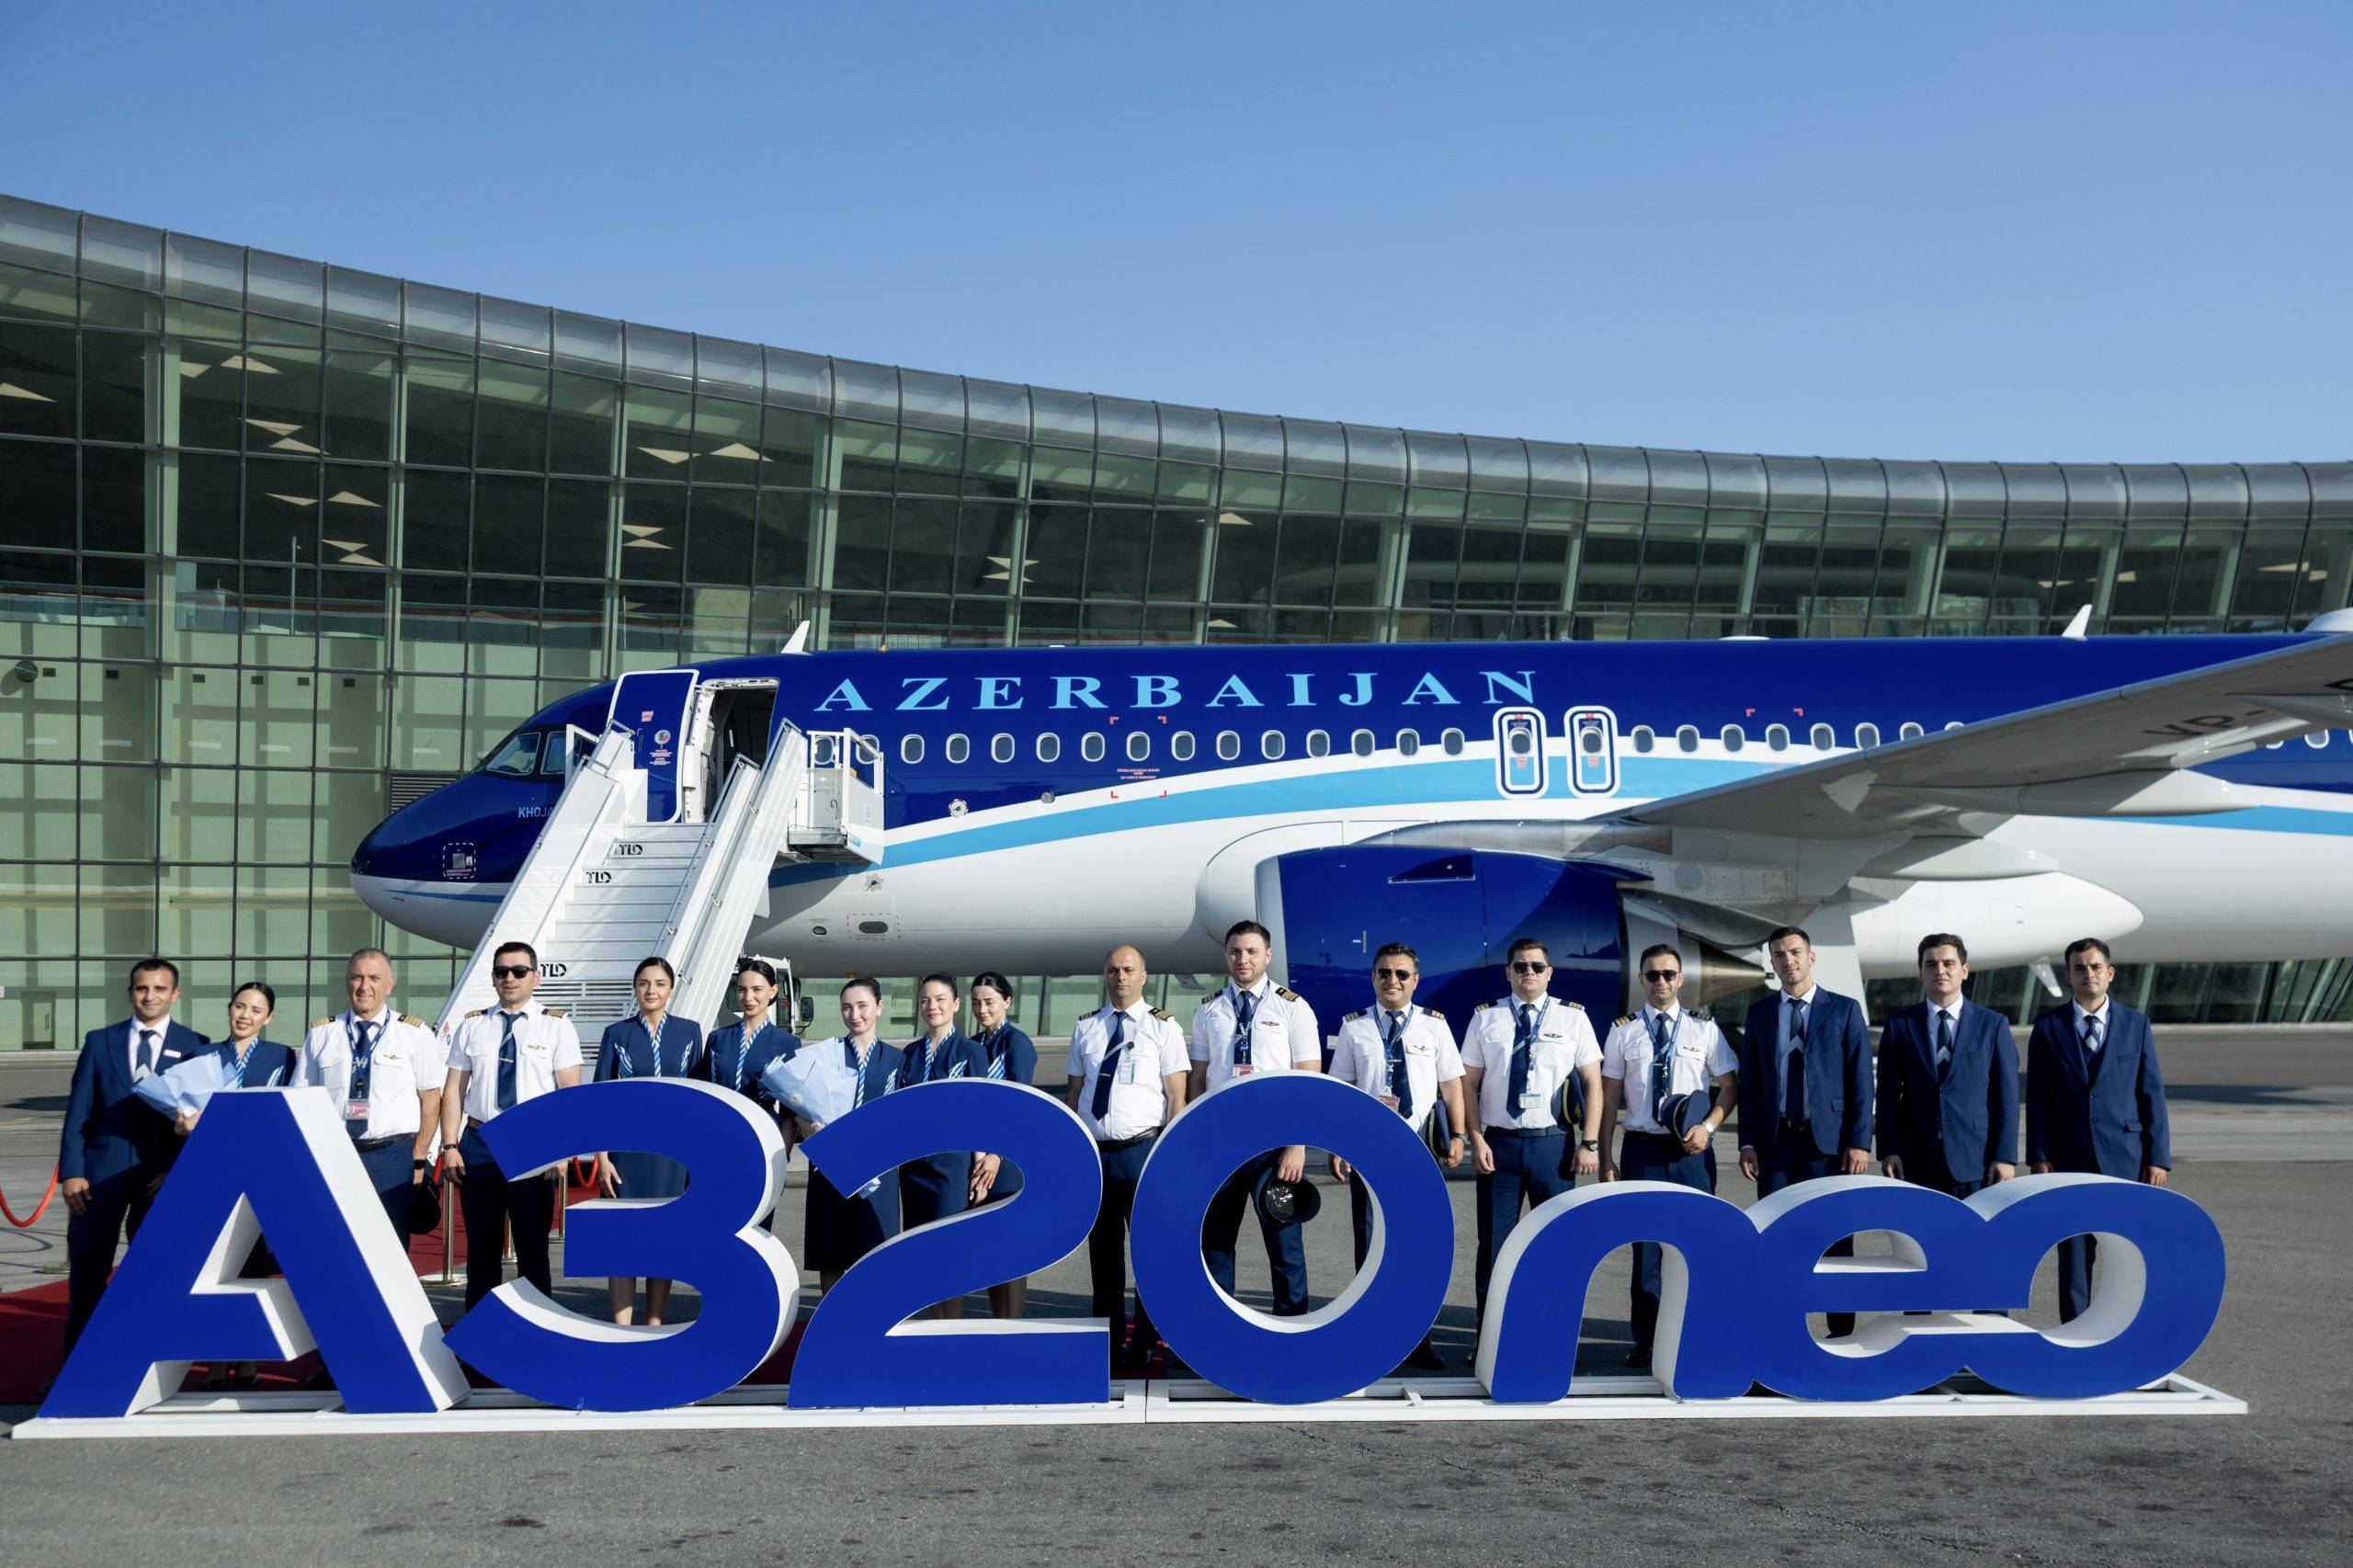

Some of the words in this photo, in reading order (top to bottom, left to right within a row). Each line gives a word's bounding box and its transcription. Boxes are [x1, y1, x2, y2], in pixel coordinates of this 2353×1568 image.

[813, 672, 1536, 711] AZERBAIJAN
[619, 844, 643, 856] TLD
[585, 871, 611, 883] TLD
[540, 963, 567, 977] TLD
